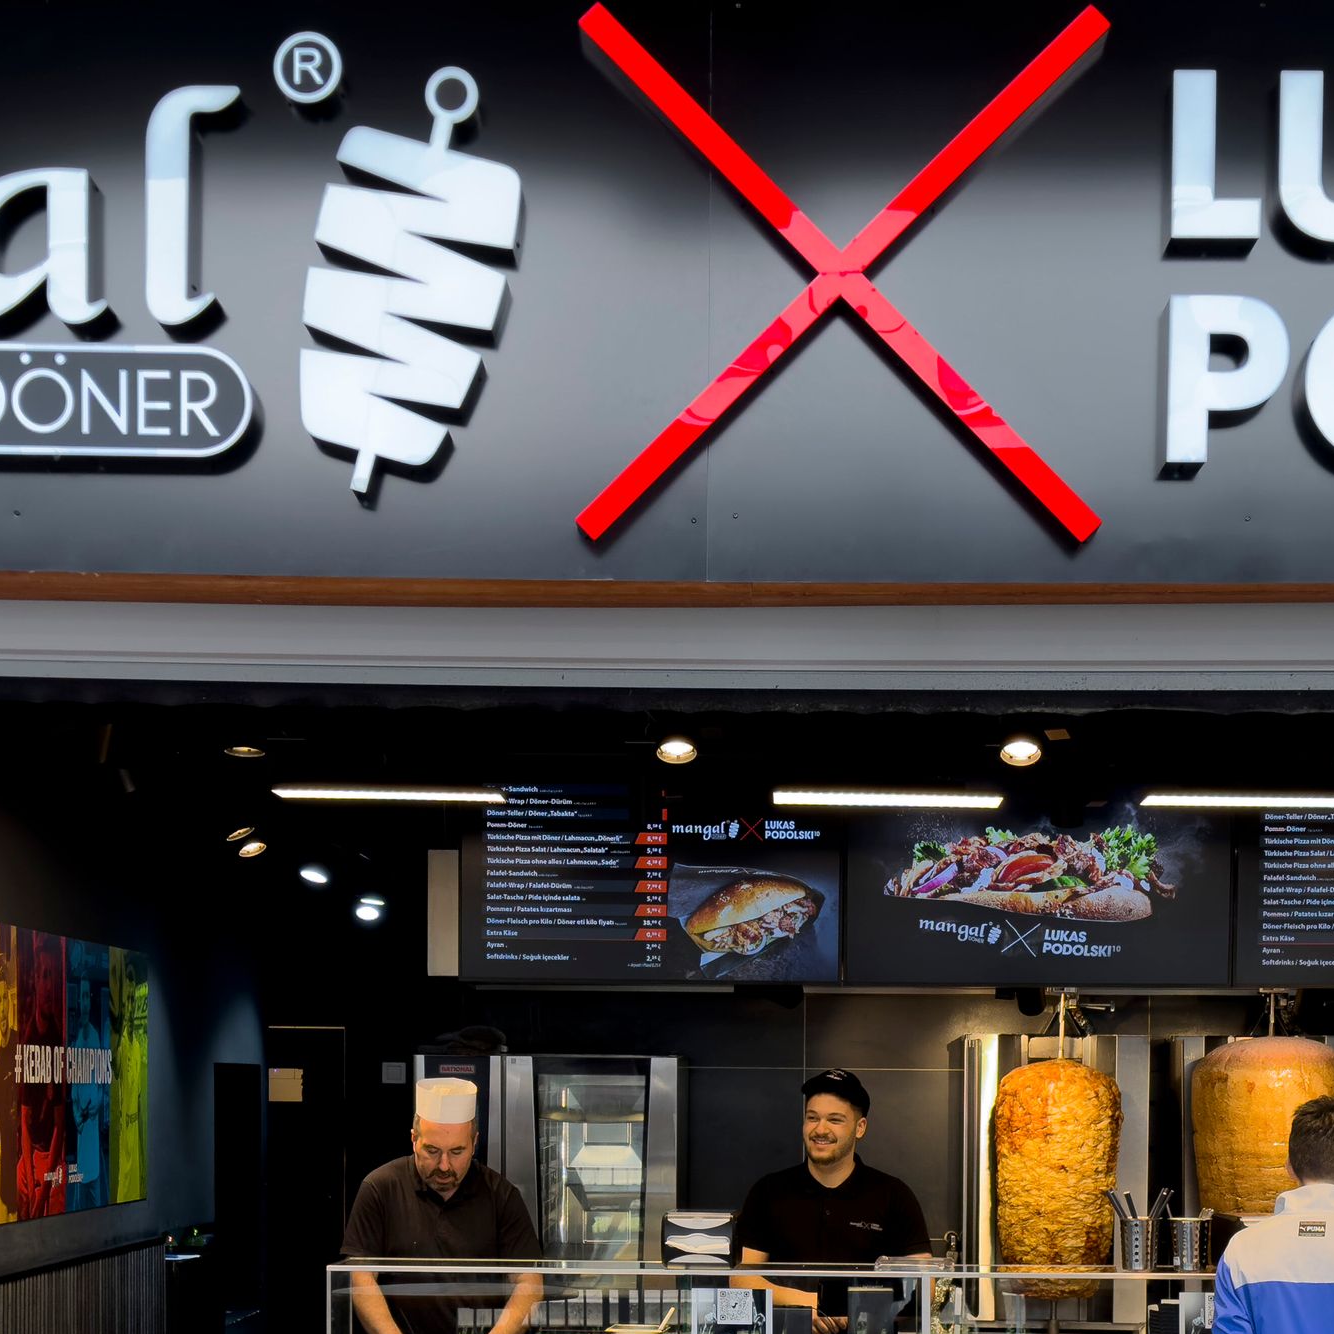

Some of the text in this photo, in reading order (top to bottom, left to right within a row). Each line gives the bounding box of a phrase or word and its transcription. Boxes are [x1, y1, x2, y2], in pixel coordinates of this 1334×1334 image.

[672, 821, 725, 840] mangal
[765, 821, 795, 830] LUKAS
[919, 920, 988, 941] mangal
[1044, 929, 1087, 942] LUKAS
[53, 1046, 65, 1084] OF
[67, 1047, 112, 1084] CHAMPIONS
